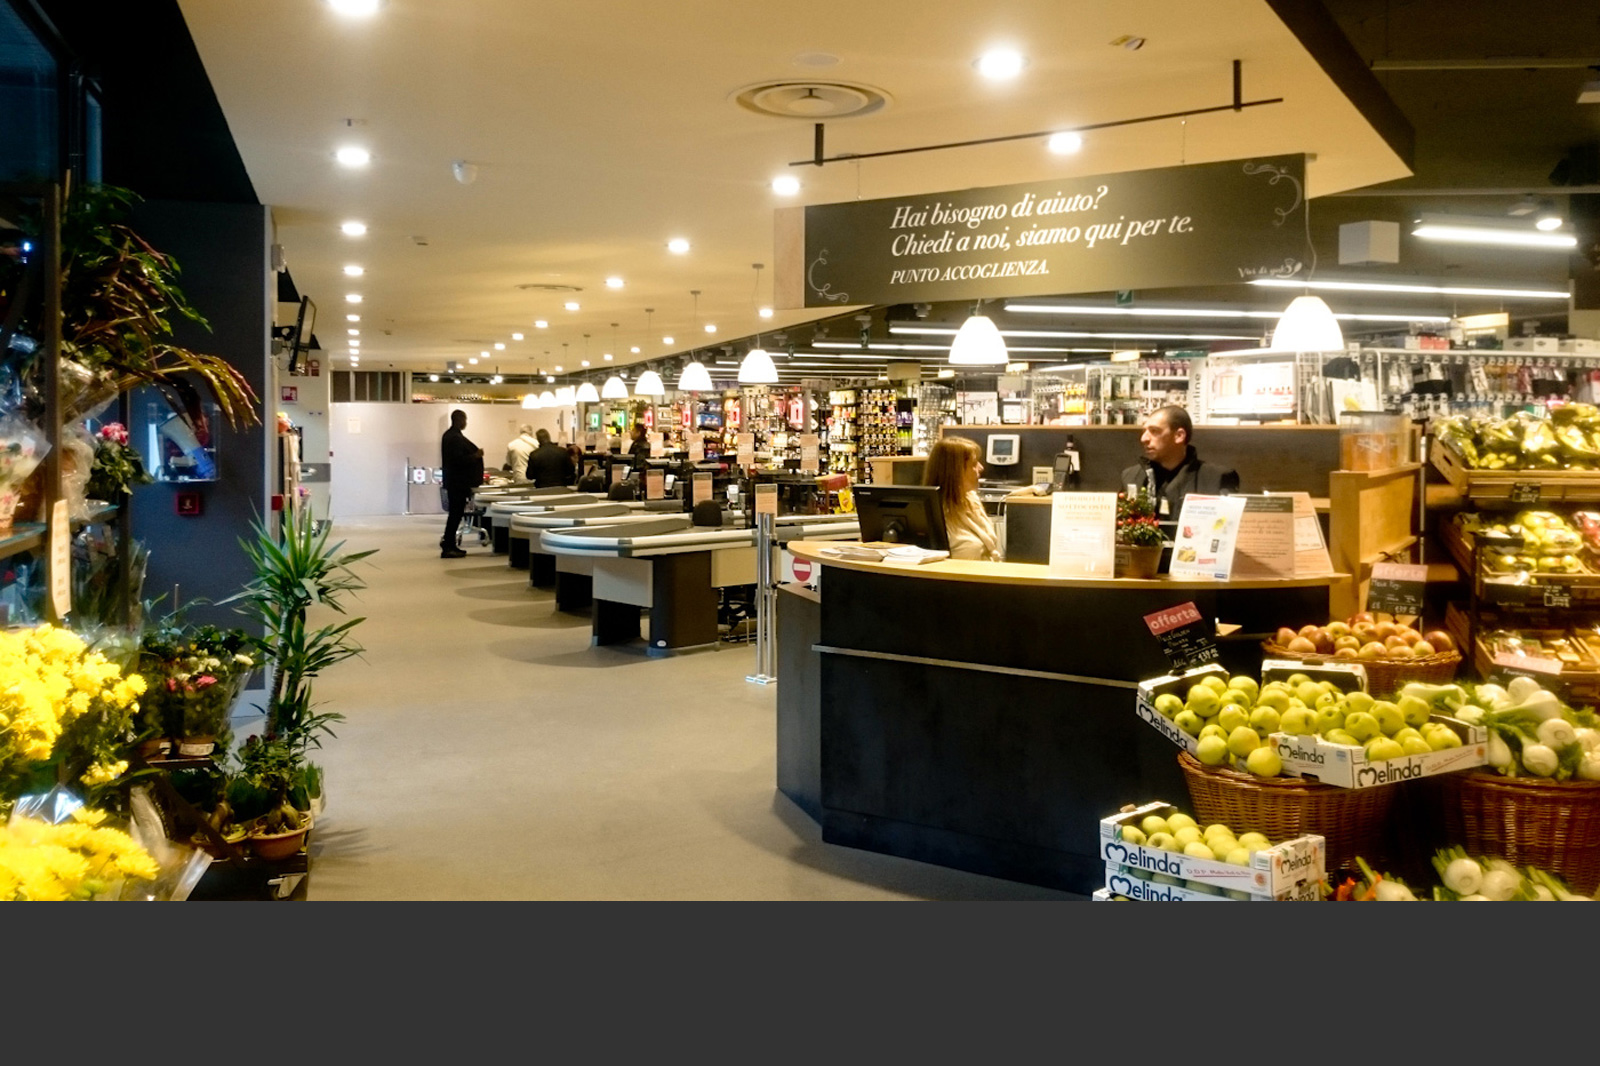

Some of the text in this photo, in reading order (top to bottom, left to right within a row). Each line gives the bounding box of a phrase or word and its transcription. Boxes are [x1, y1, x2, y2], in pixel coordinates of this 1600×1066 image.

[889, 185, 1108, 229] Hai bisogno di aiuto?
[891, 214, 1194, 256] Chiedi a noi, siamo qui per te.
[890, 259, 1050, 284] PUNTO ACCOGLIENZA.
[1150, 608, 1197, 630] offerta
[1138, 703, 1189, 750] Melinda
[1278, 744, 1325, 764] Melinda
[1357, 759, 1422, 787] Melinda
[1105, 842, 1181, 876] Melinda
[1280, 850, 1312, 874] Melinda
